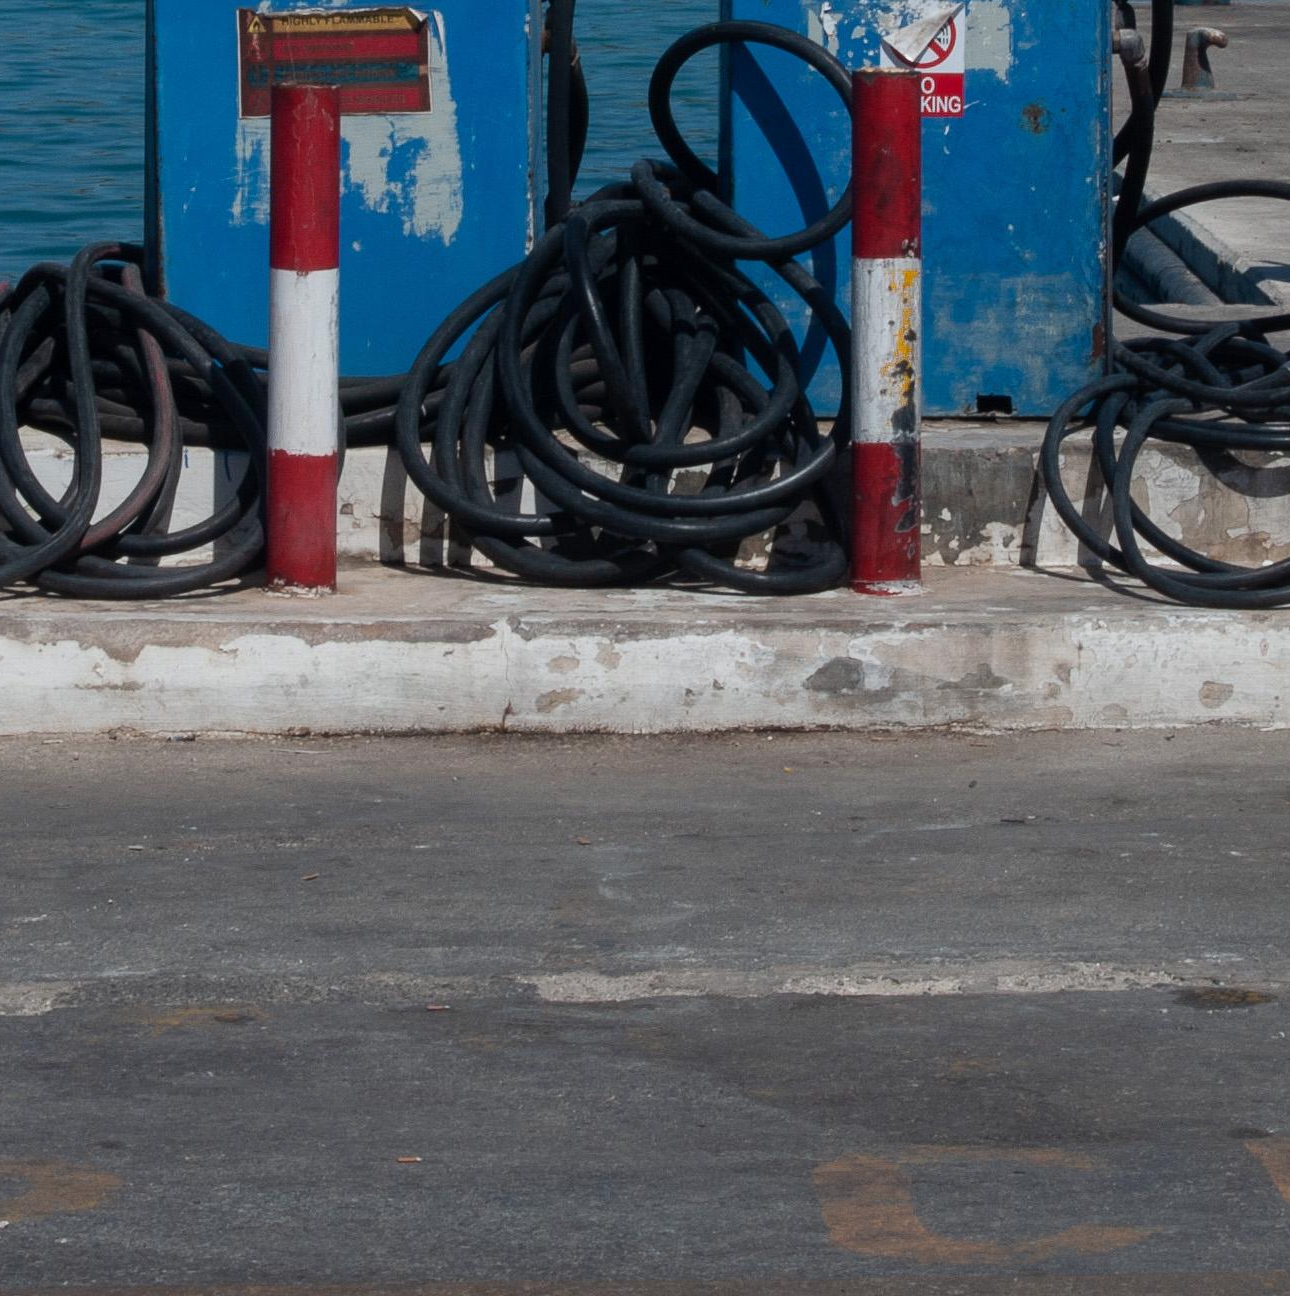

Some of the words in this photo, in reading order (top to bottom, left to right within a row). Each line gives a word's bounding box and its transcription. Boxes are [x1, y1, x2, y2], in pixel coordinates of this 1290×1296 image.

[281, 16, 321, 26] HIGHLY
[325, 14, 395, 25] FLAMMABLE
[920, 76, 936, 95] O
[920, 95, 962, 113] KING
